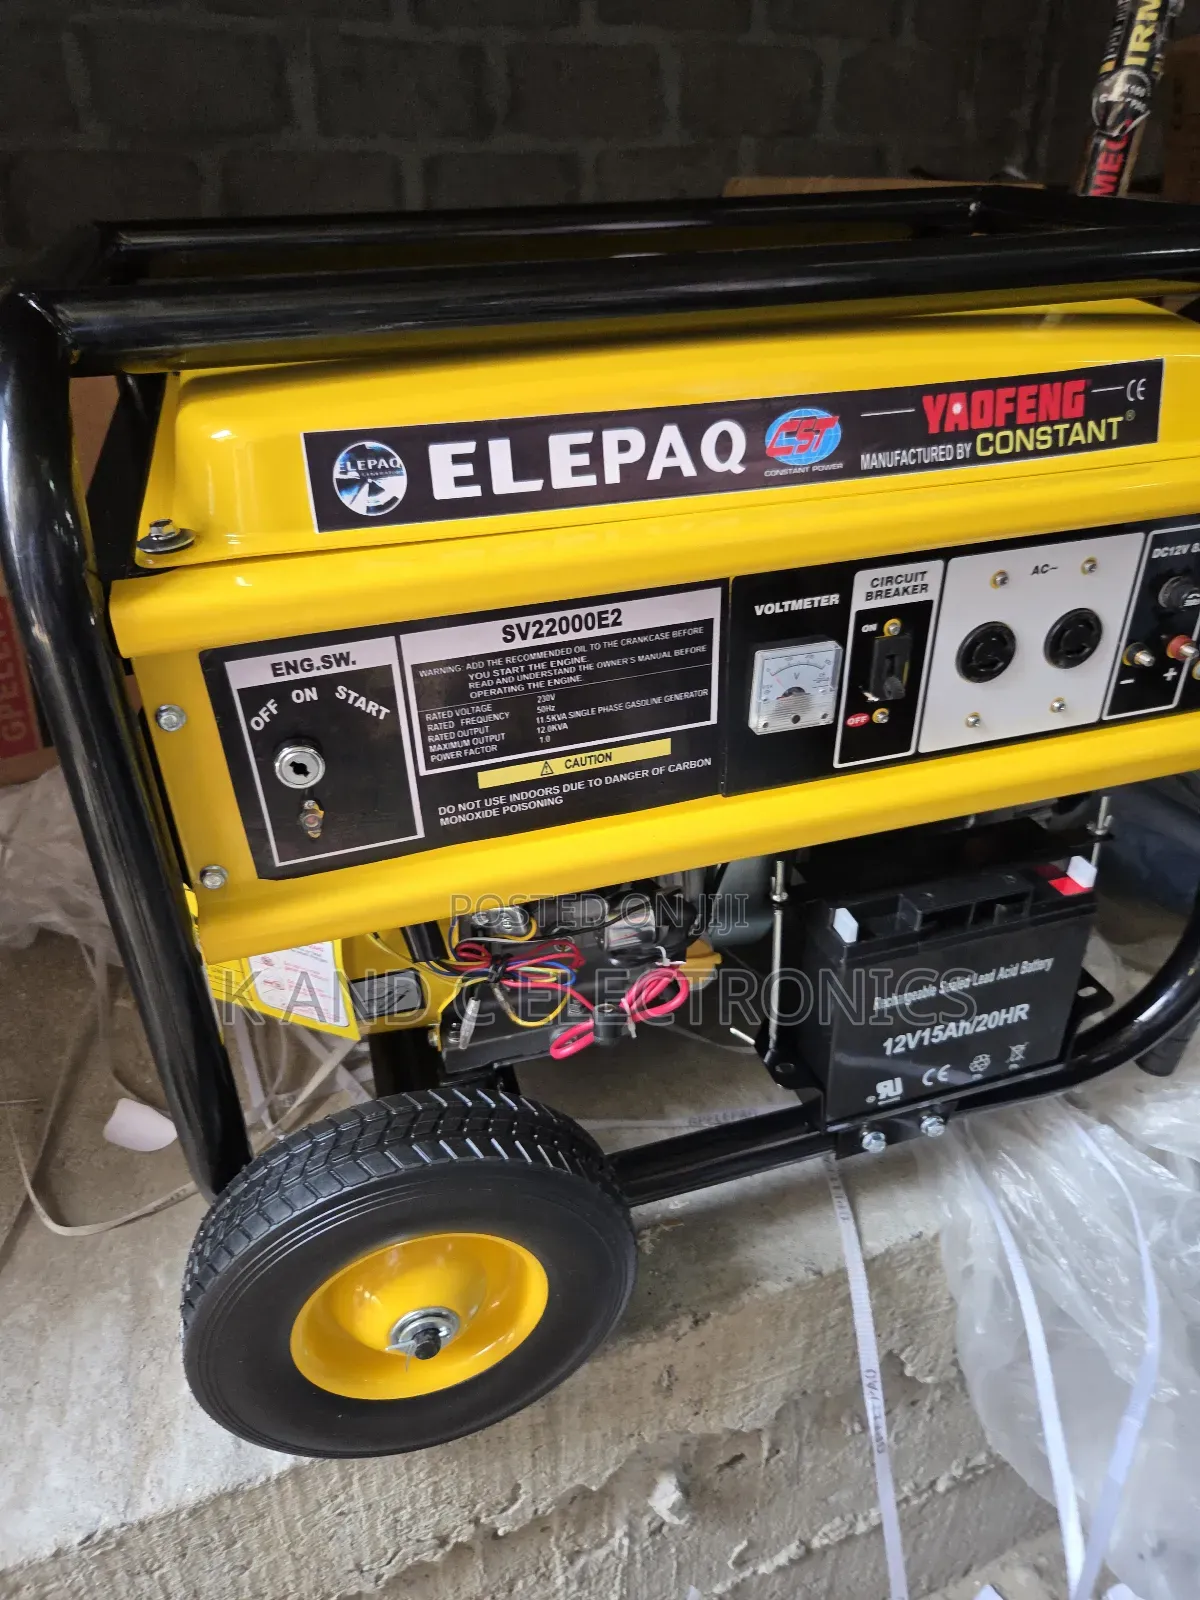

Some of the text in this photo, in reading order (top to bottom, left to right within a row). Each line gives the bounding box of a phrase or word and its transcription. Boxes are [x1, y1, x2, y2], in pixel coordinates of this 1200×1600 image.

[922, 379, 1086, 435] YAOFENG
[766, 415, 840, 458] CST
[428, 419, 747, 501] ELEPAQ
[764, 462, 844, 477] CONSTANT POWER
[860, 444, 954, 471] MANUFACTURED
[956, 442, 973, 460] BY
[865, 583, 929, 602] BREAKER
[870, 571, 928, 588] CIRCUIT
[754, 593, 840, 616] VOLTMETER
[501, 607, 623, 644] SV22000E2
[861, 623, 878, 633] ON
[270, 651, 357, 678] ENG.SW.
[419, 626, 704, 678] WARNING: ADD THE RECOMMENDED OIL TO THE CRANKCASE BEFORE
[468, 644, 707, 690] READ AND UNDERSTAND THE OWNER'S MANUAL BEFORE
[468, 671, 491, 681] YOU
[492, 666, 525, 677] START
[527, 661, 548, 672] THE
[291, 686, 319, 704] ON
[334, 685, 391, 721] START
[470, 684, 525, 699] OPERATING
[527, 680, 546, 690] THE
[250, 699, 279, 732] OFF
[425, 693, 556, 721] RATED VOLTAGE 230V
[427, 731, 456, 743] RATED
[456, 725, 490, 738] OUTPUT
[568, 707, 597, 719] SINGLE
[598, 702, 623, 714] PHASE
[625, 696, 663, 709] GASOLINE
[664, 688, 709, 703] GENERATOR
[427, 705, 556, 732] RATED FREQUENCY 50Hz
[846, 715, 868, 725] OFF
[429, 739, 471, 753] MAXIMUM
[472, 732, 506, 746] OUTPUT
[431, 735, 551, 763] POWER FACTOR 1.0
[564, 752, 612, 770] CAUTION
[438, 757, 712, 816] DO NOT USE INDOORS DUE TO DANGER OF CARBON
[439, 796, 564, 826] MONOXIDE POISONING
[882, 1003, 1030, 1056] 12V15Ah/20HR
